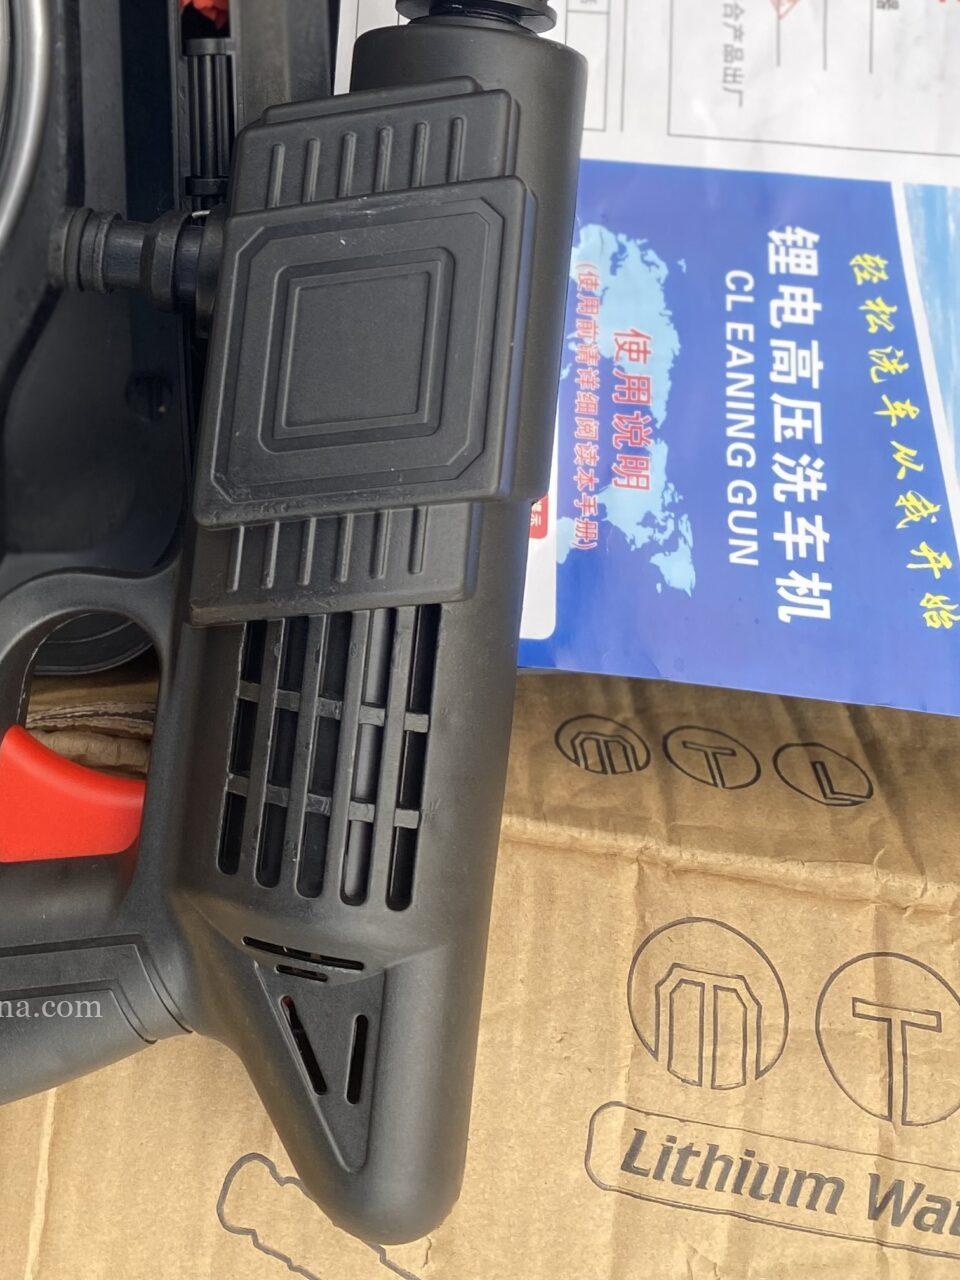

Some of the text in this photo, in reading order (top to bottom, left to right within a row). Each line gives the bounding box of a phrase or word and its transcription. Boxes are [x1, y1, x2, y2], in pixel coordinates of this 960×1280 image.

[613, 327, 653, 493] 使用说明
[767, 225, 833, 624] 锂电高压洗车机
[727, 478, 759, 567] GUN
[620, 1127, 846, 1215] Lithium
